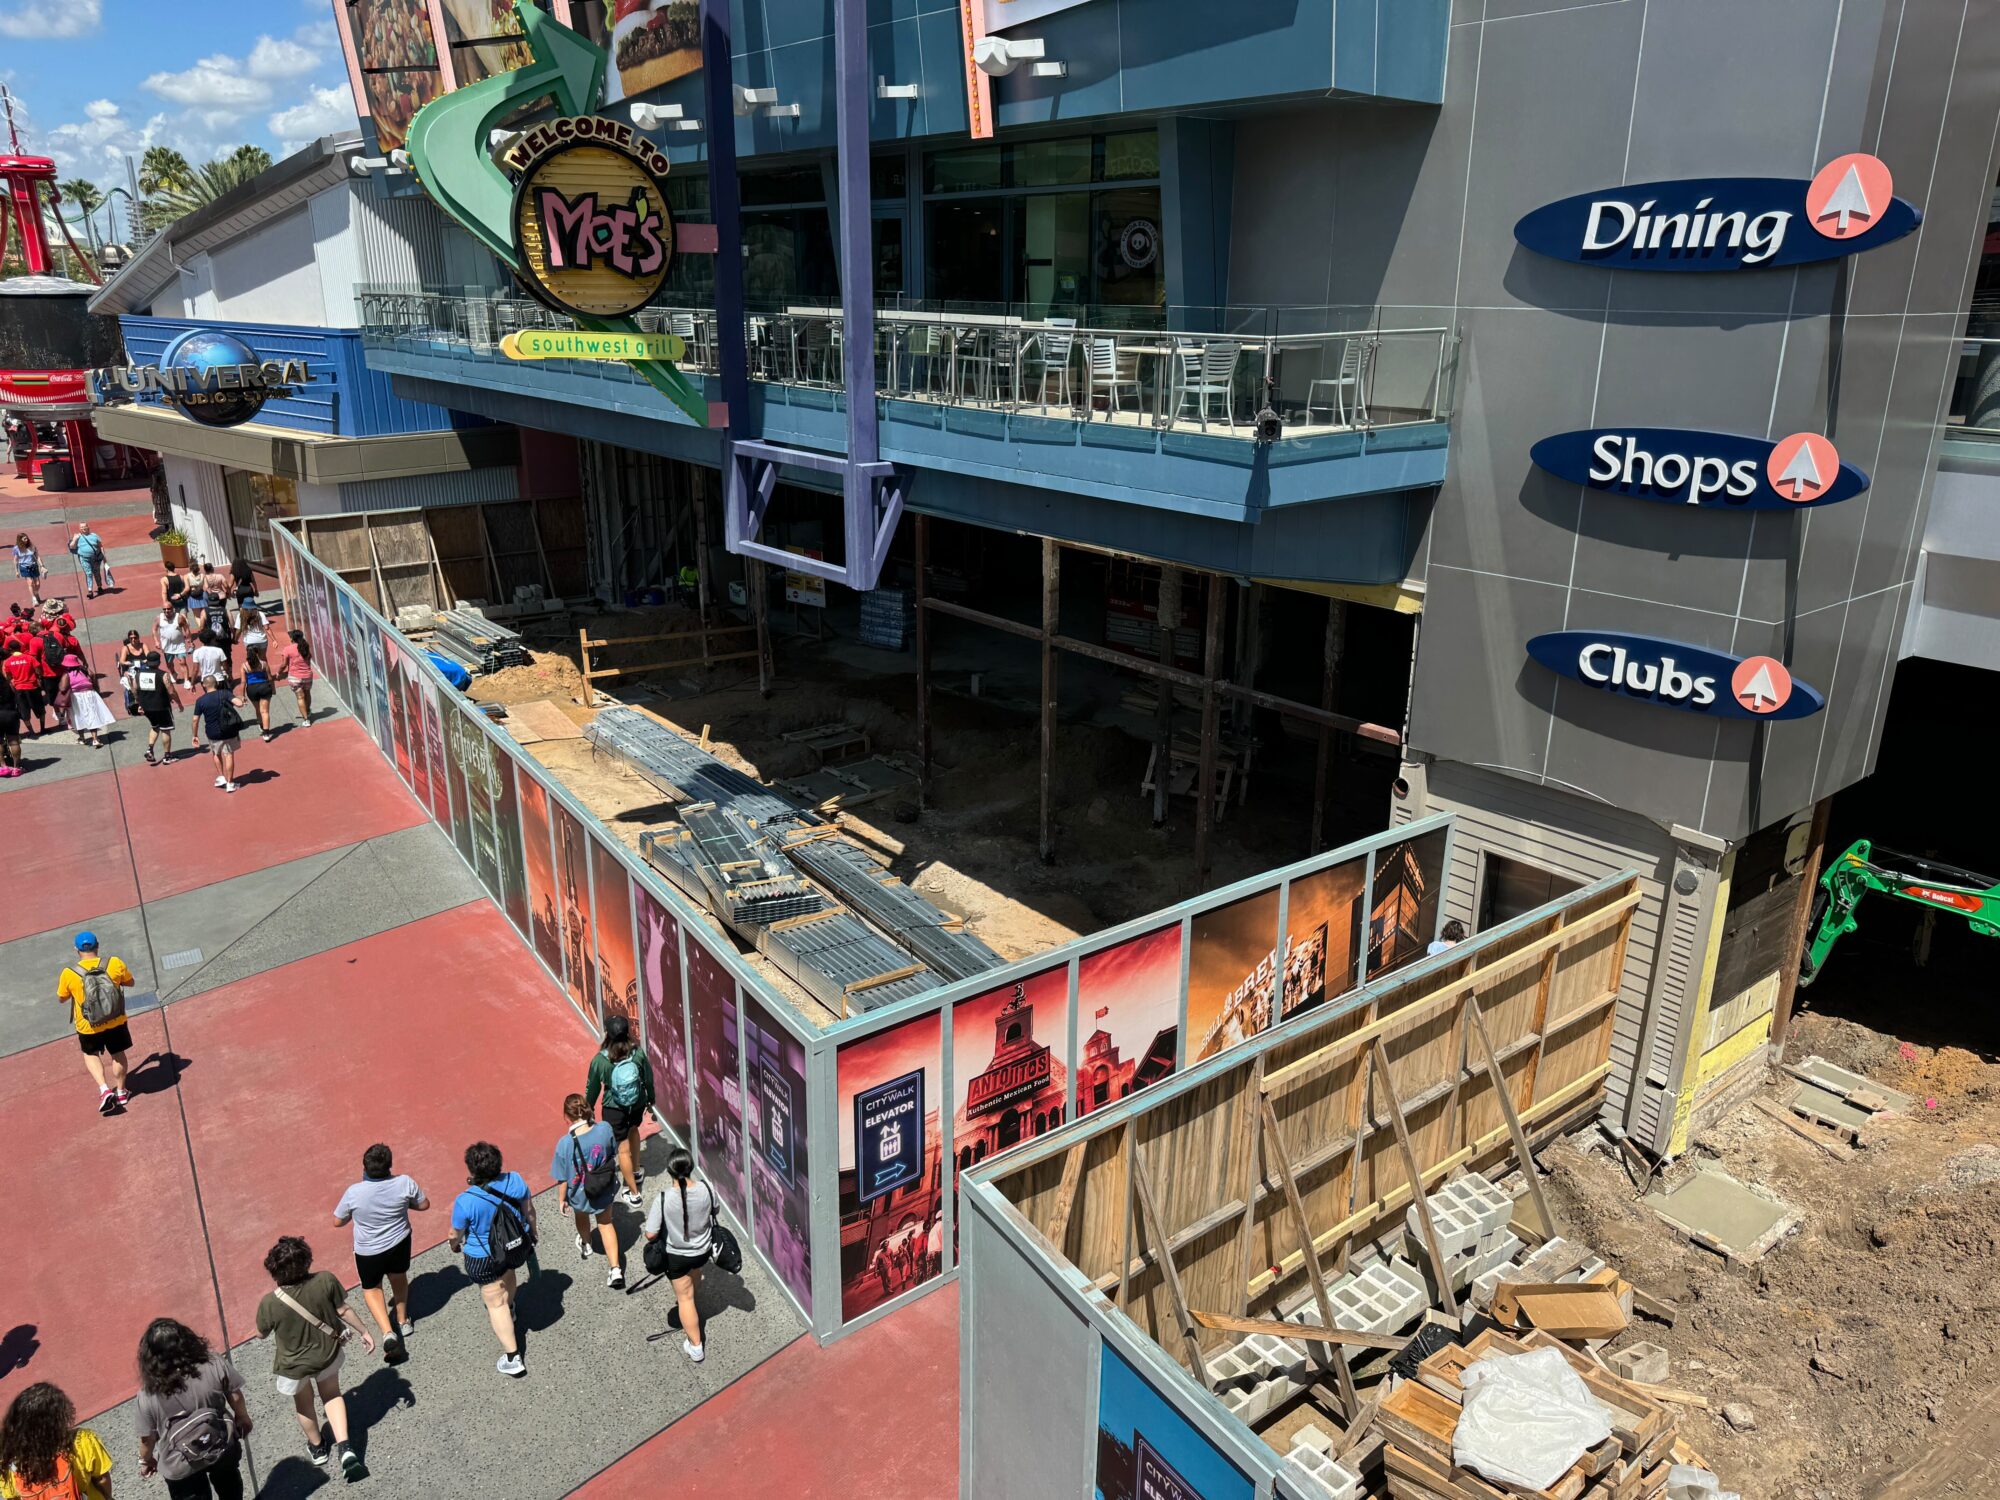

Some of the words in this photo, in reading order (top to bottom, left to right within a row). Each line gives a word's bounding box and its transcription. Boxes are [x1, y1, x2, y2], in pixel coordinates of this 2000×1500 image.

[508, 116, 632, 170] WELCOME
[637, 141, 670, 174] TO
[1581, 196, 1793, 264] Dining
[532, 335, 629, 354] southwest
[635, 338, 674, 357] grill
[118, 361, 317, 392] UNIVERSAL
[161, 390, 240, 406] STUDIOS
[1588, 434, 1758, 504] Shops
[1578, 642, 1717, 705] Clubs
[1931, 892, 1955, 904] Bobcat
[763, 1069, 789, 1101] CITYWALK
[967, 1096, 1003, 1117] Authentic
[1003, 1083, 1033, 1101] Mexican
[1033, 1074, 1050, 1088] Food
[971, 1054, 1047, 1104] ANTOJITOS
[763, 1082, 790, 1118] ELEVATOR
[865, 1084, 915, 1112] CITYWALK
[865, 1100, 915, 1129] ELEVATOR
